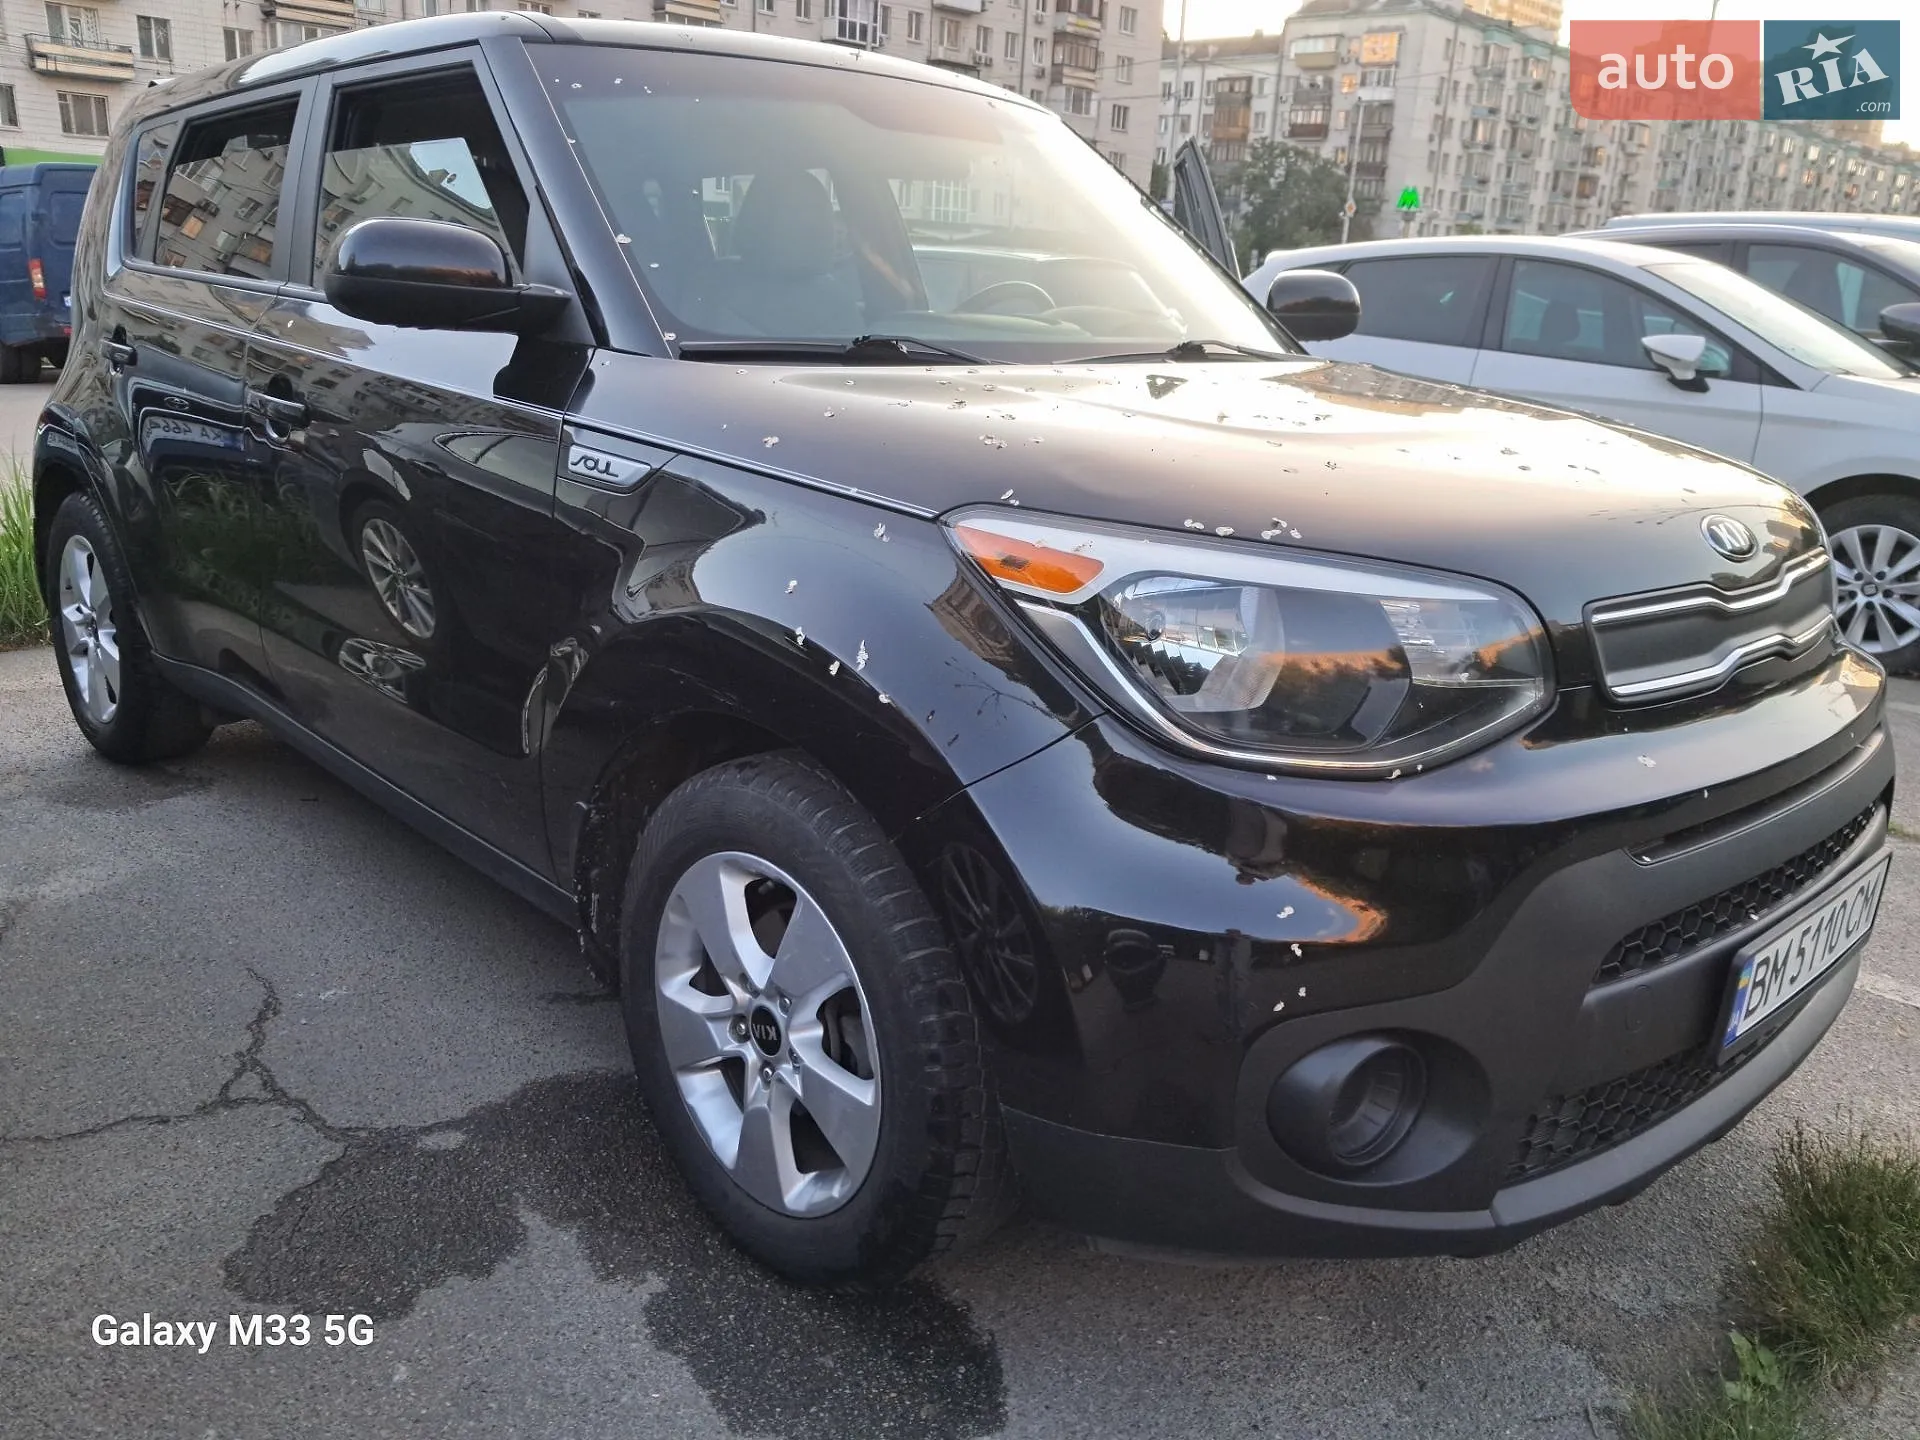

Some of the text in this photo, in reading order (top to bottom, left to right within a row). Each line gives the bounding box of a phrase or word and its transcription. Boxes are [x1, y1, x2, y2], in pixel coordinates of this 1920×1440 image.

[1744, 872, 1881, 1019] BM 5110 CM
